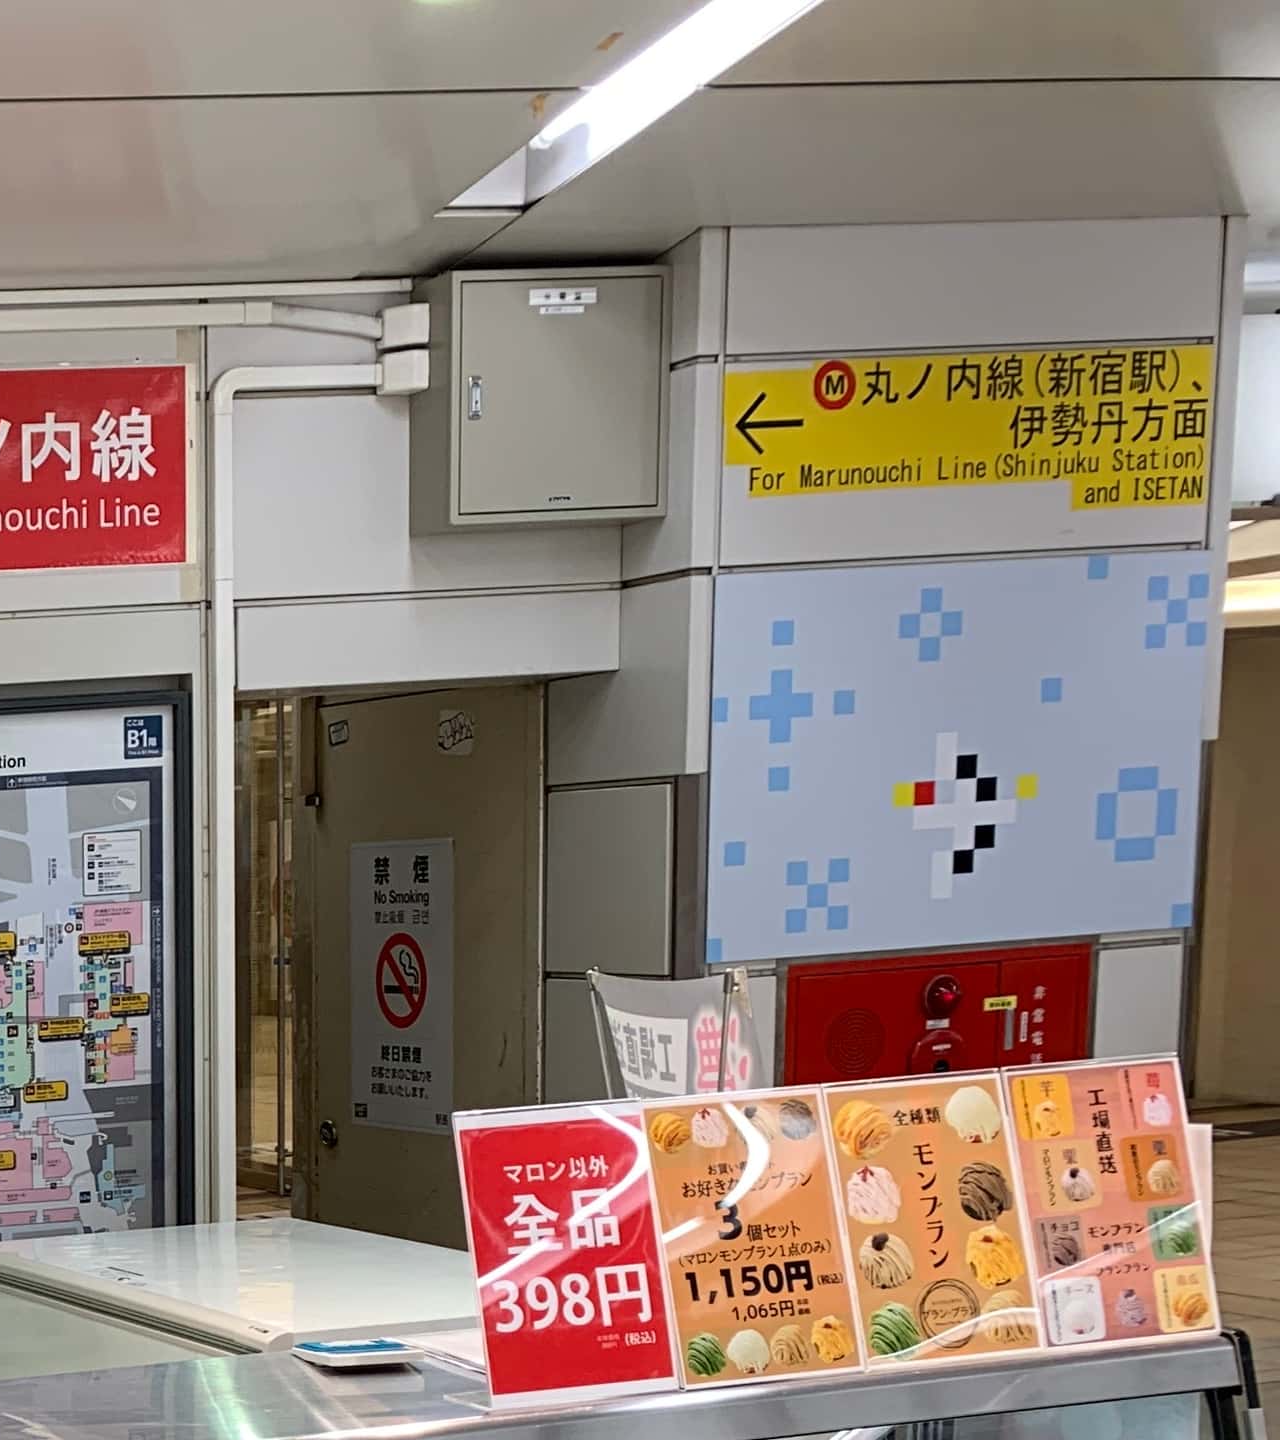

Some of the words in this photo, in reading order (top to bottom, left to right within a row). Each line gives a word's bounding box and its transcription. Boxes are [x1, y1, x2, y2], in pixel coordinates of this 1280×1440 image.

[1009, 402, 1207, 447] 伊勢丹方面
[748, 467, 785, 494] For
[799, 457, 922, 489] Marunouchi
[937, 455, 986, 482] Line
[1112, 445, 1205, 474] Station)
[1083, 479, 1122, 504] and
[1133, 476, 1204, 502] ISETAN
[100, 498, 161, 528] Line
[374, 890, 387, 904] No
[389, 889, 429, 907] Smoking
[893, 1106, 941, 1128] 全種類
[1087, 1088, 1119, 1175] 工場直送
[503, 1155, 609, 1184] マロン以外
[505, 1188, 621, 1256] 全品
[912, 1143, 949, 1269] モンブラン
[492, 1262, 654, 1334] 398円
[685, 1260, 814, 1304] 1,150円
[731, 1300, 795, 1322] 1,065円
